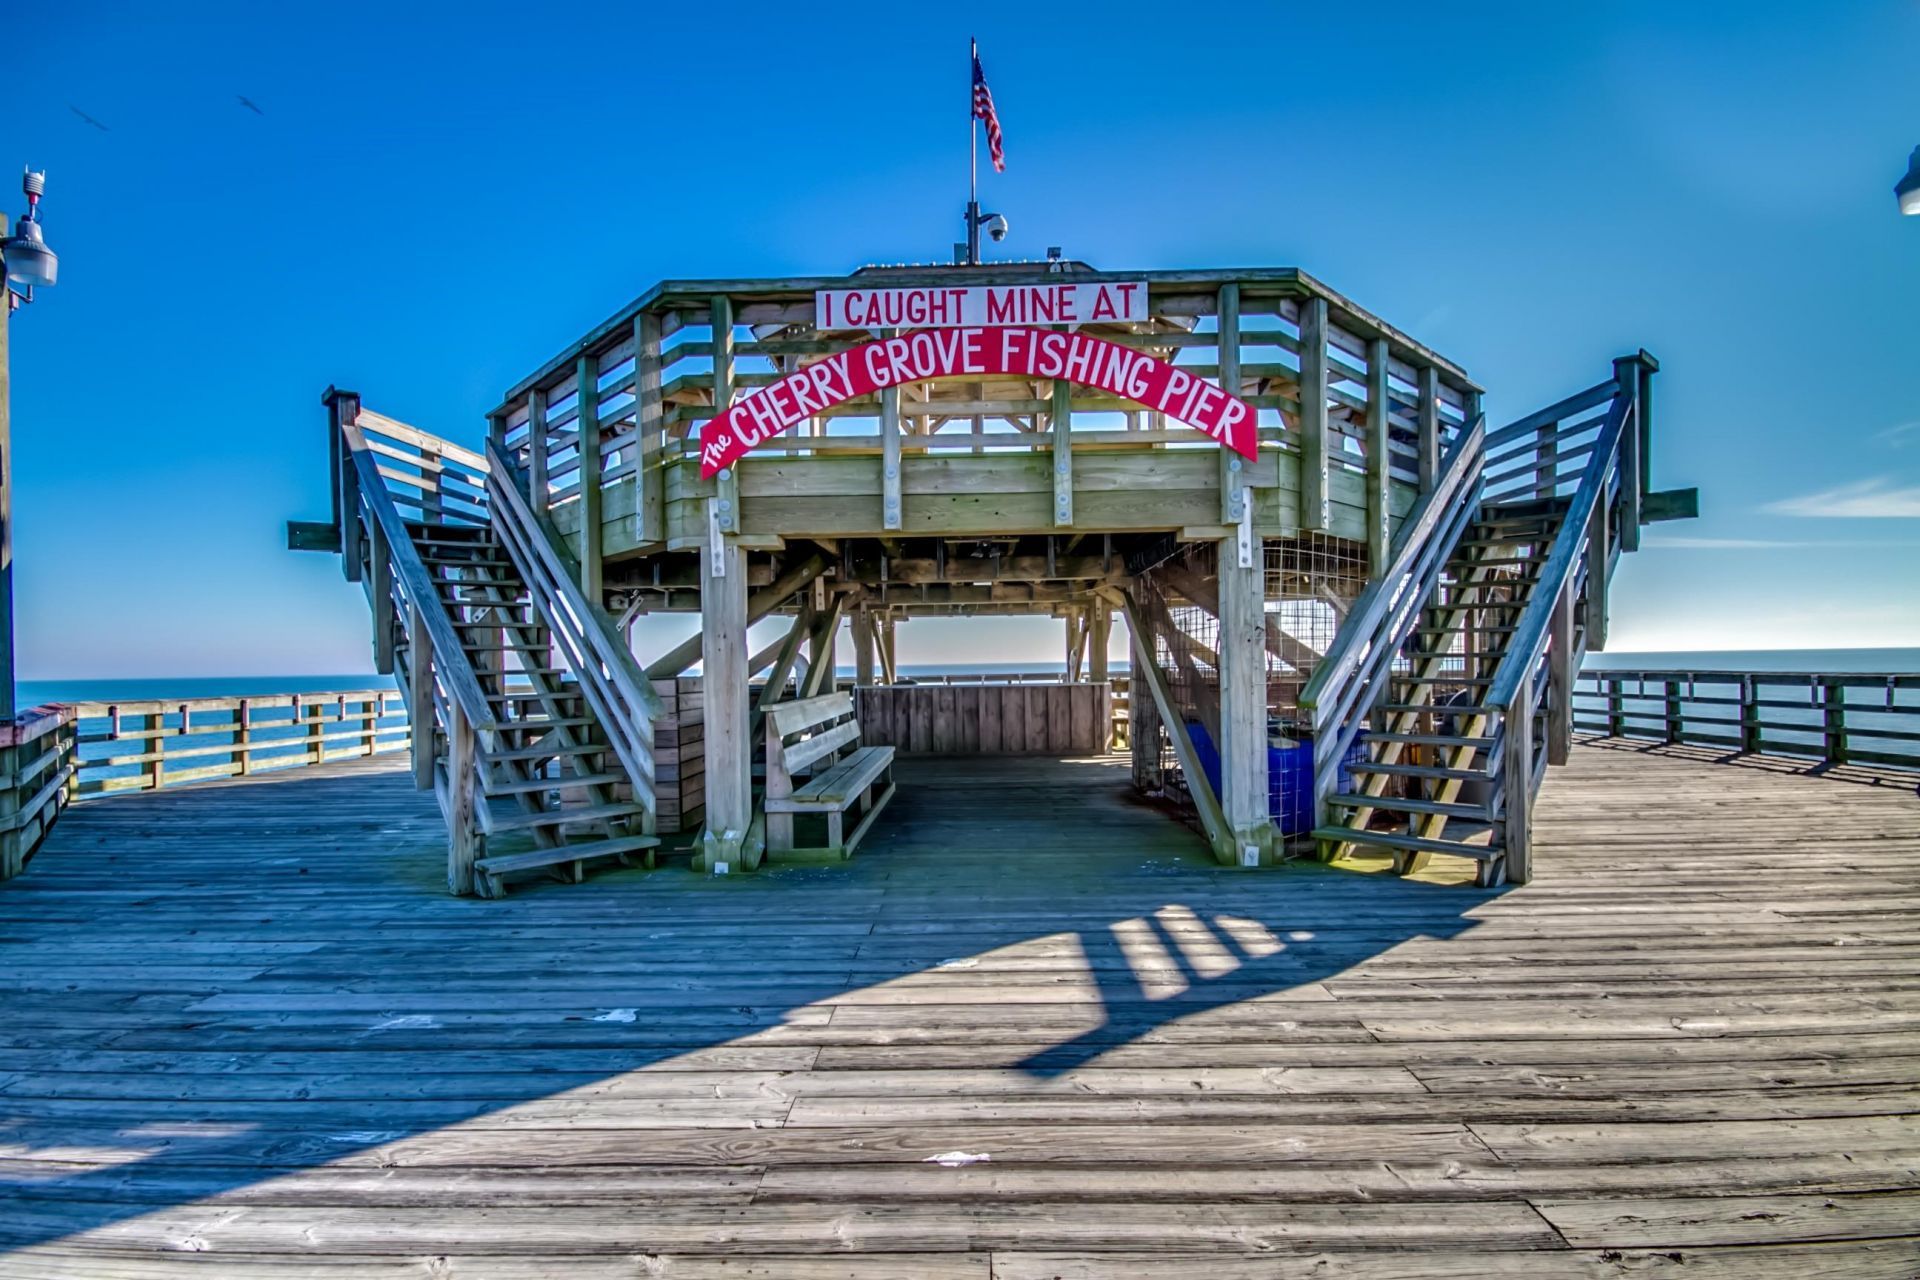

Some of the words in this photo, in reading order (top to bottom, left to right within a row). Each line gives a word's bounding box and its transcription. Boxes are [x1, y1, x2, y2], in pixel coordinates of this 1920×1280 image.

[826, 293, 833, 326] I
[844, 289, 968, 326] CAUGHT
[987, 285, 1077, 323] MINE
[1092, 284, 1137, 322] AT
[702, 434, 731, 469] The
[729, 355, 855, 447] CHERRY
[865, 328, 984, 388] GROVE
[1001, 329, 1155, 399] FISHING
[1157, 367, 1246, 447] PIER
